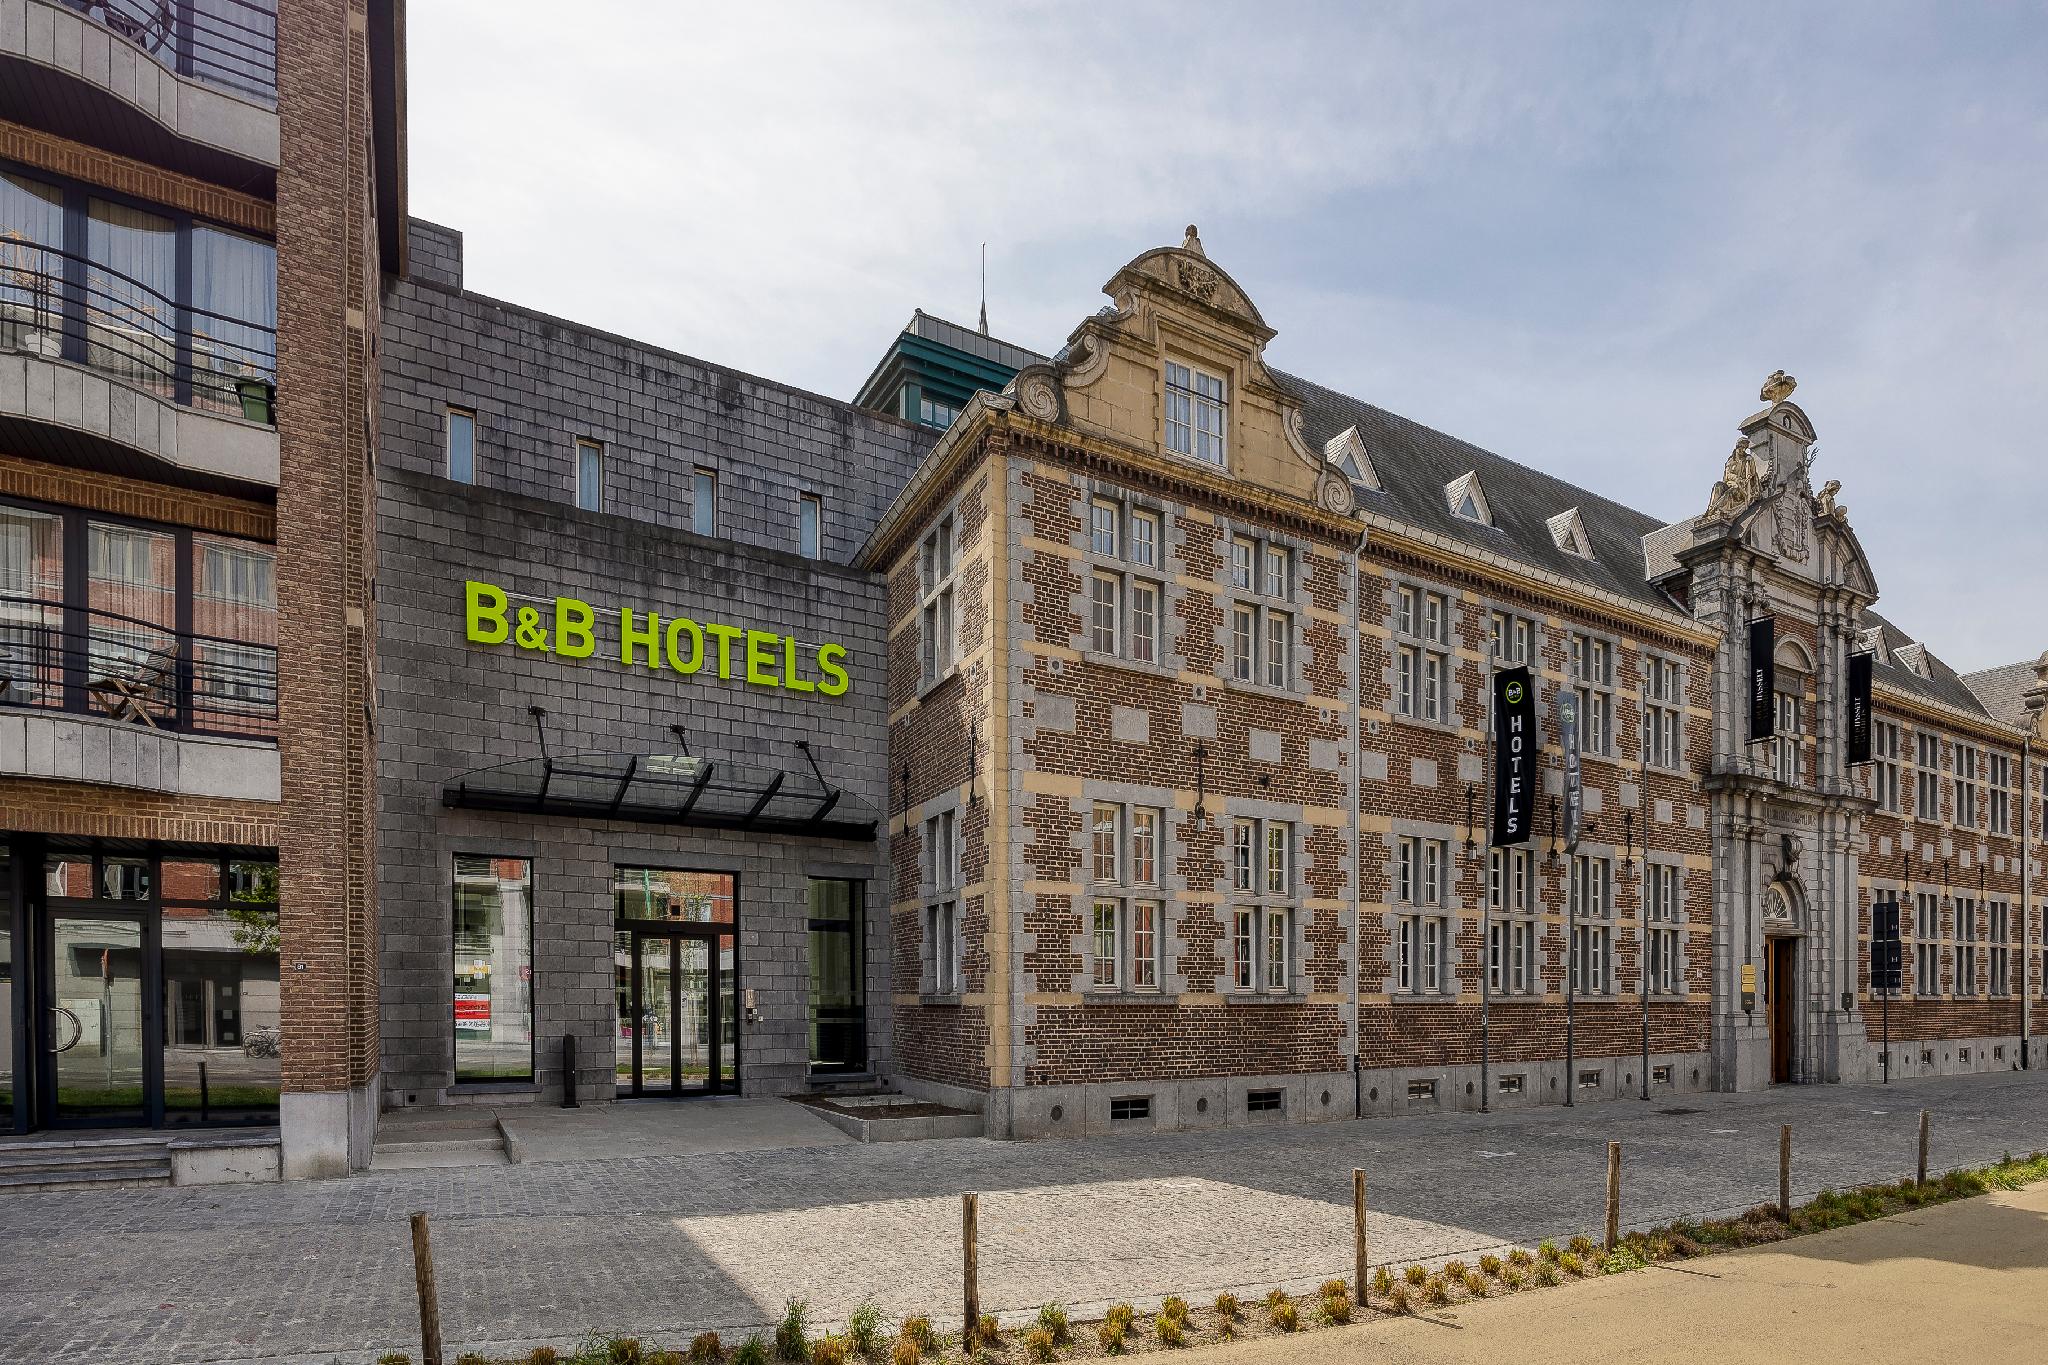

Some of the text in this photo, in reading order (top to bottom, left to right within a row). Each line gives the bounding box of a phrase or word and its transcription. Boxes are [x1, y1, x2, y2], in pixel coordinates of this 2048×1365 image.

[465, 580, 849, 695] B&B HOTELS
[1507, 715, 1522, 834] HOTELS
